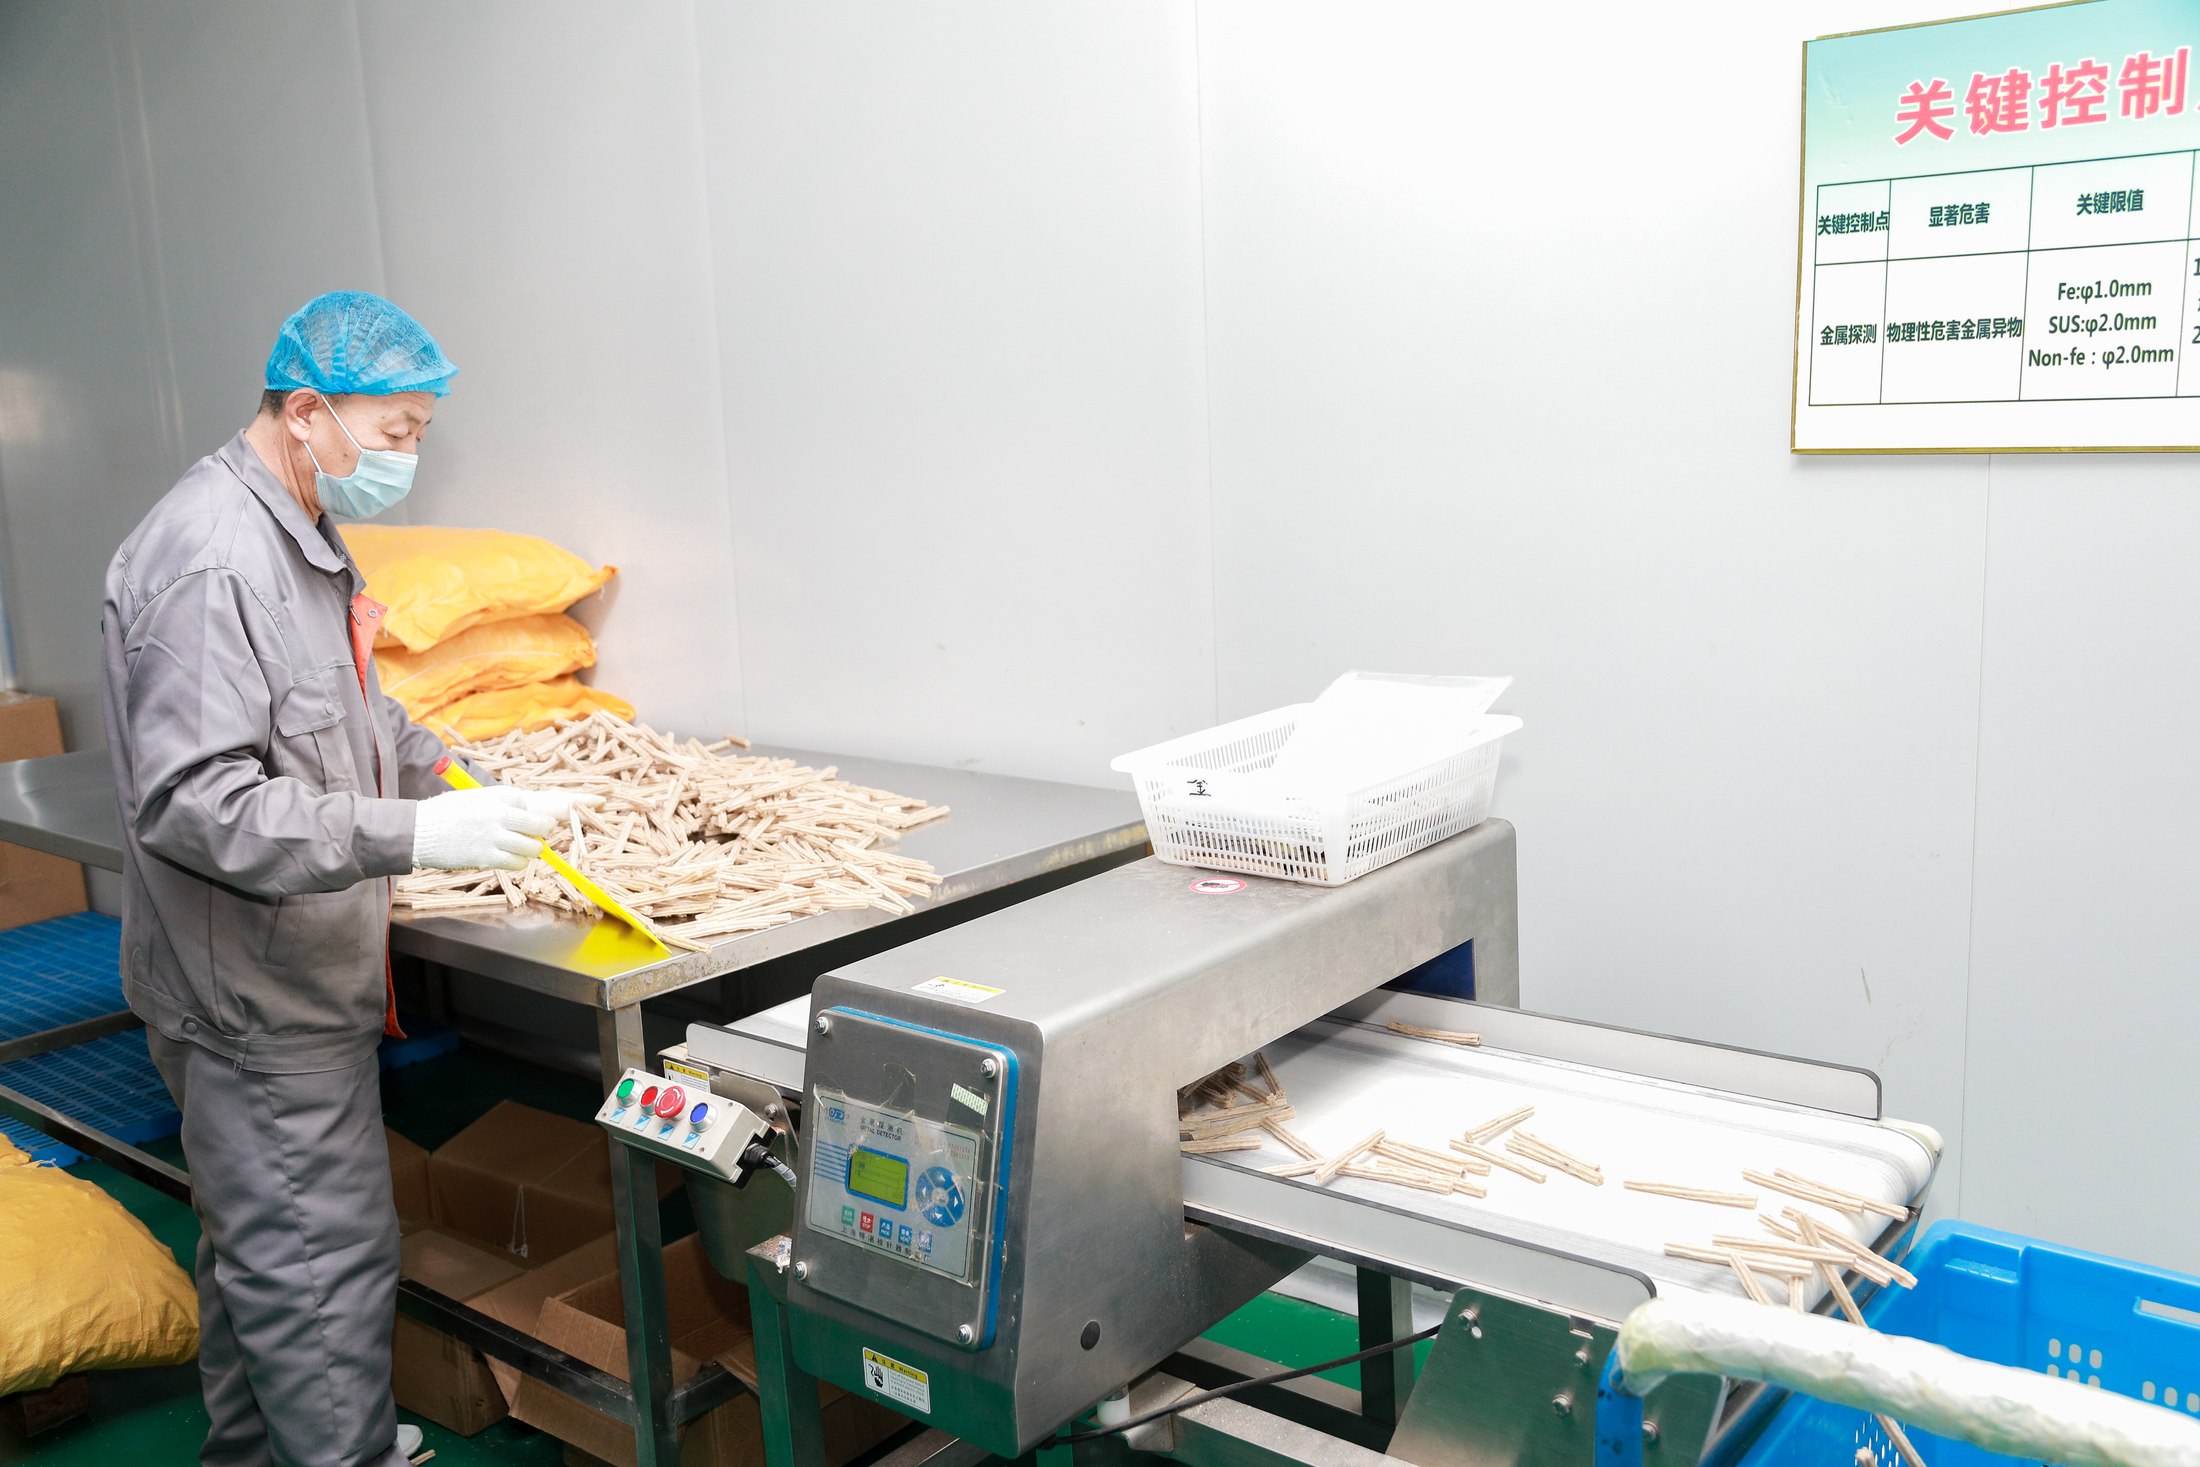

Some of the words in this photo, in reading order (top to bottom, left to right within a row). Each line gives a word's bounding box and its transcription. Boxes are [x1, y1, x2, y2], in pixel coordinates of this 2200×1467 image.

[1894, 48, 2200, 145] 关键控制
[1928, 202, 1990, 228] 显著危害
[2076, 189, 2144, 216] 关键限值
[1817, 210, 1889, 237] 关键控制点
[2058, 280, 2152, 304] Fe:φ1.0mm
[1820, 324, 1877, 346] 金属探测
[1886, 317, 2023, 343] 物理性危害金属异物
[2048, 313, 2157, 338] SUS:φ2.0mm
[876, 1130, 902, 1141] DETECTOR
